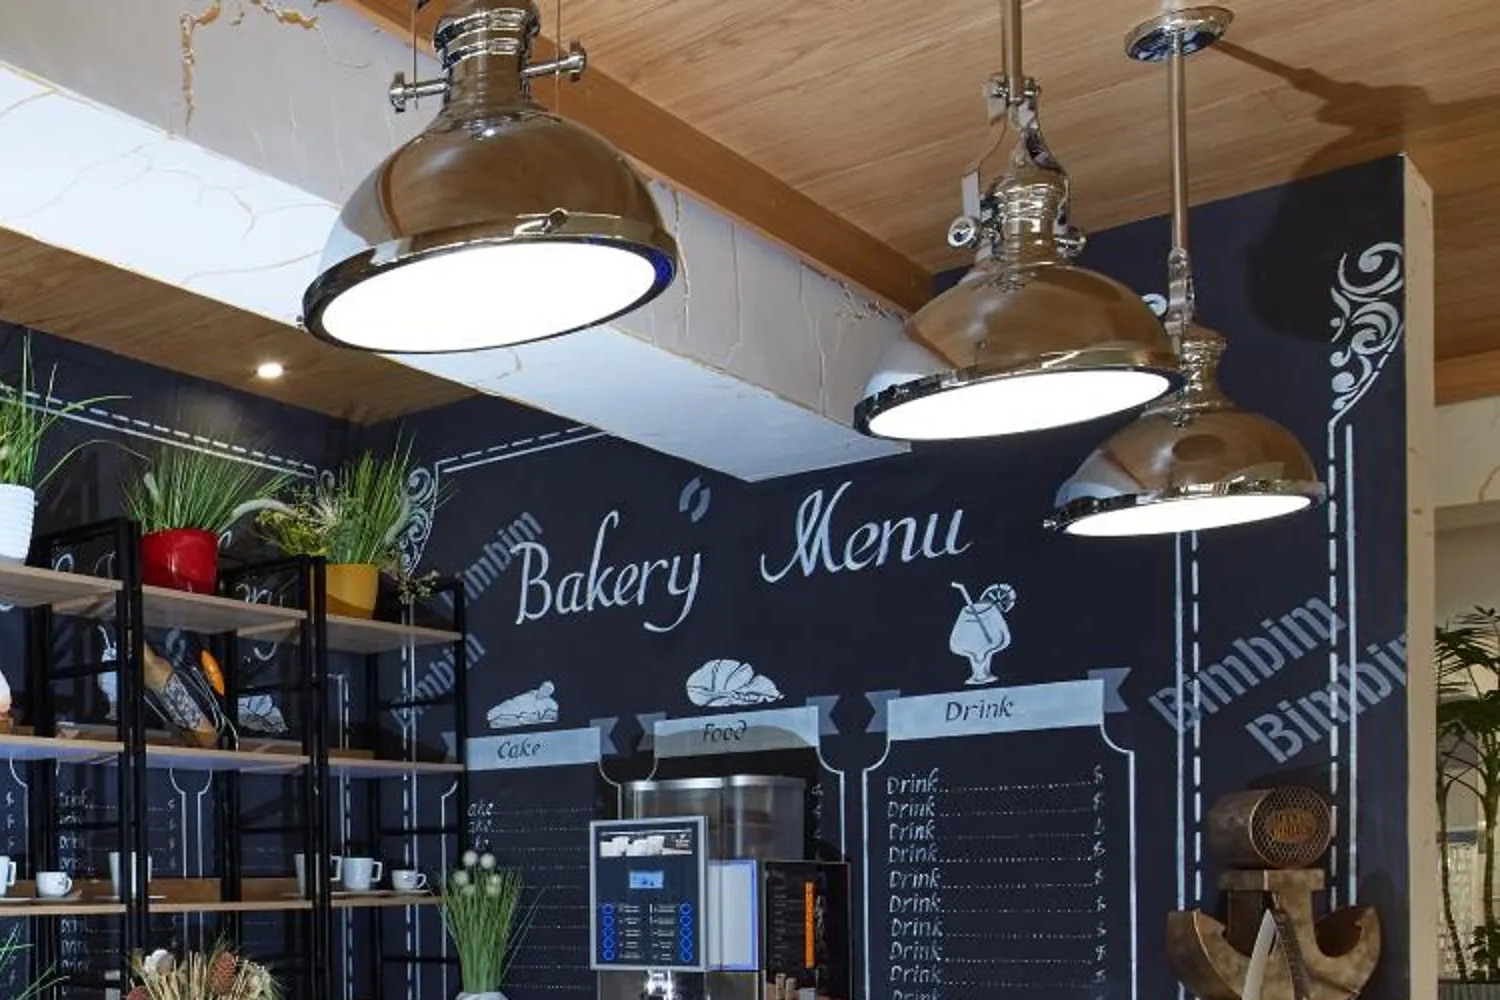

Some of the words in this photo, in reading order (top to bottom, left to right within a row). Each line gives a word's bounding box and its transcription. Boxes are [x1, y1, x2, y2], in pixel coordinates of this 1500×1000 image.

[512, 510, 700, 633] Bakery
[761, 481, 974, 583] Menu
[1148, 597, 1347, 732] Bimbim
[944, 698, 1013, 723] Drink
[703, 719, 747, 741] Food
[497, 738, 541, 761] Cake
